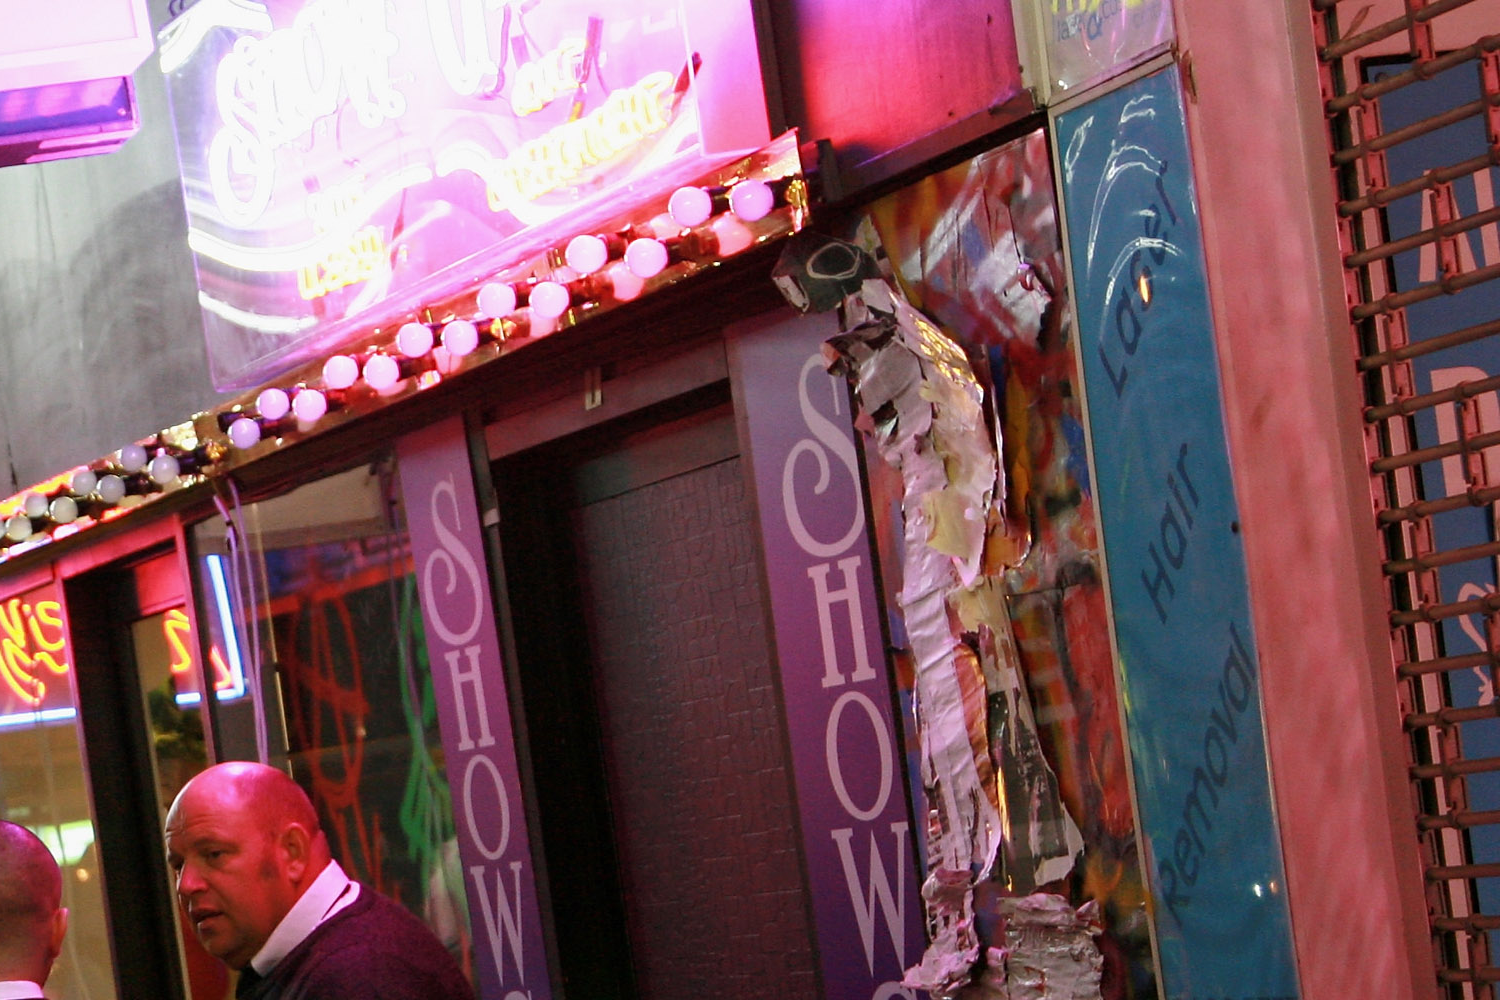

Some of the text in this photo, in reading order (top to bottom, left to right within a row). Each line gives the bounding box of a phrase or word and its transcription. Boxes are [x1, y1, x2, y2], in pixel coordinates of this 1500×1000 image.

[1100, 159, 1177, 398] Laser
[1141, 442, 1200, 625] Hair
[1157, 620, 1257, 927] Removal
